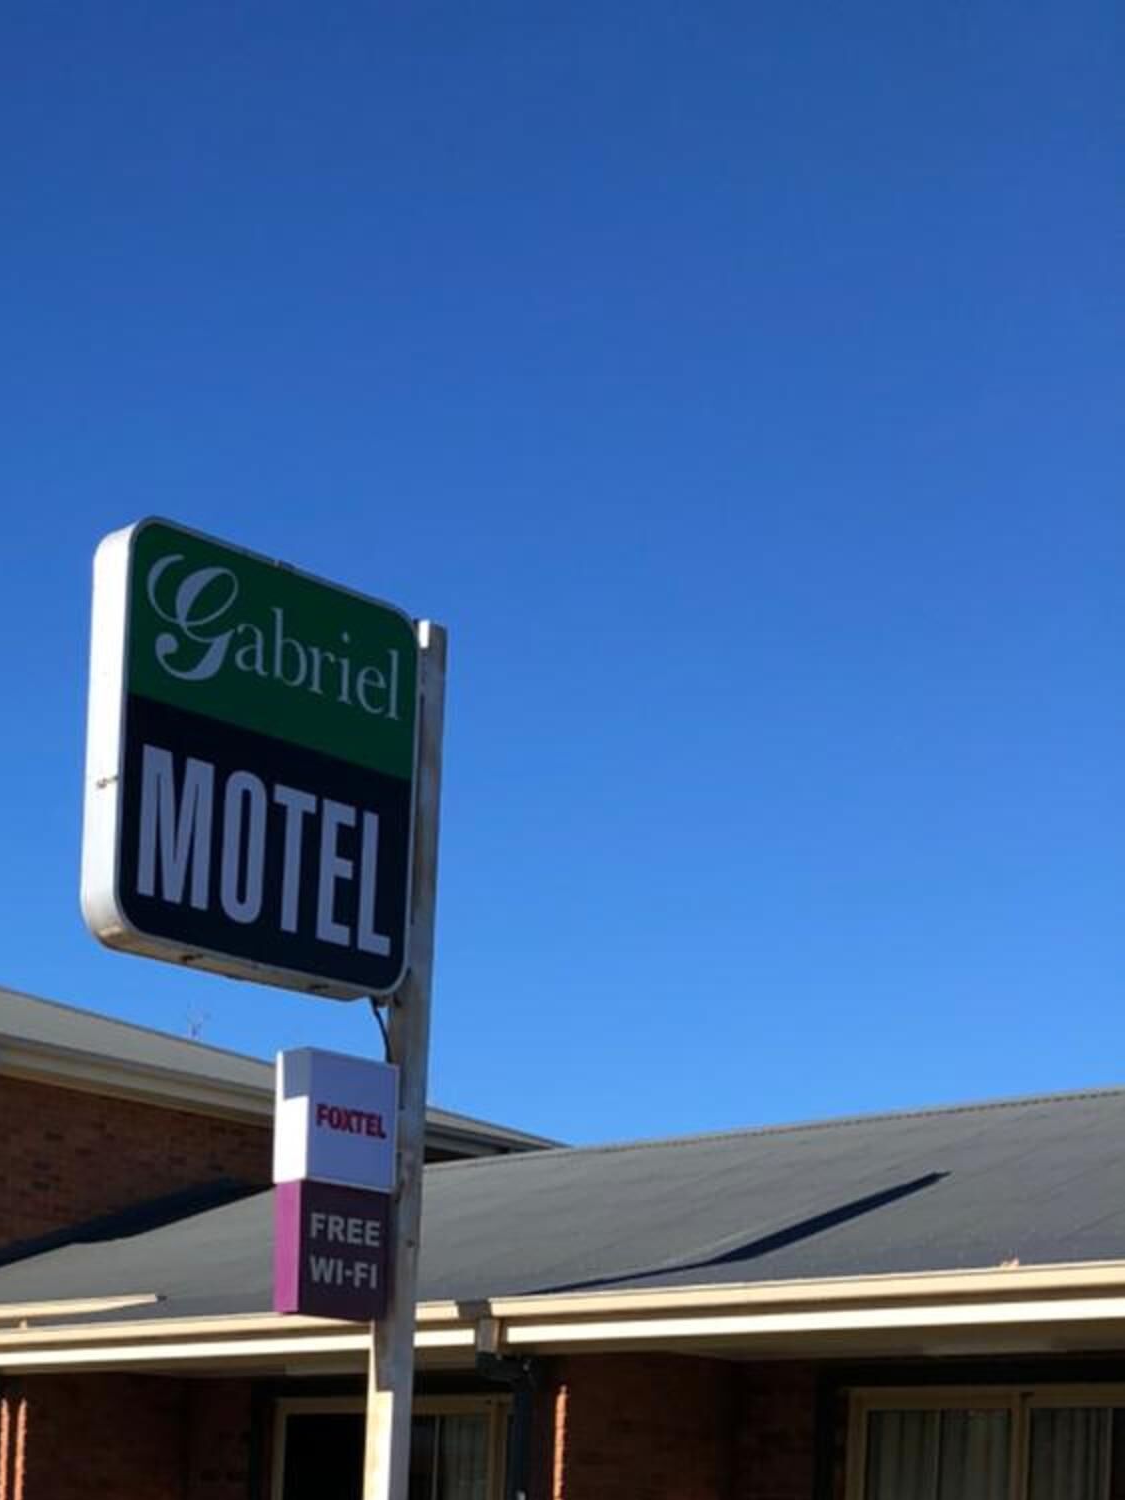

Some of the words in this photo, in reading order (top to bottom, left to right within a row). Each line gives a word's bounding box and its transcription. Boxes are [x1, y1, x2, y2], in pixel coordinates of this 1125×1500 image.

[147, 554, 402, 720] Gabriel
[136, 744, 391, 957] MOTEL
[316, 1103, 386, 1139] FOXTEL
[310, 1212, 380, 1246] FREE
[310, 1255, 376, 1288] WI-FI
